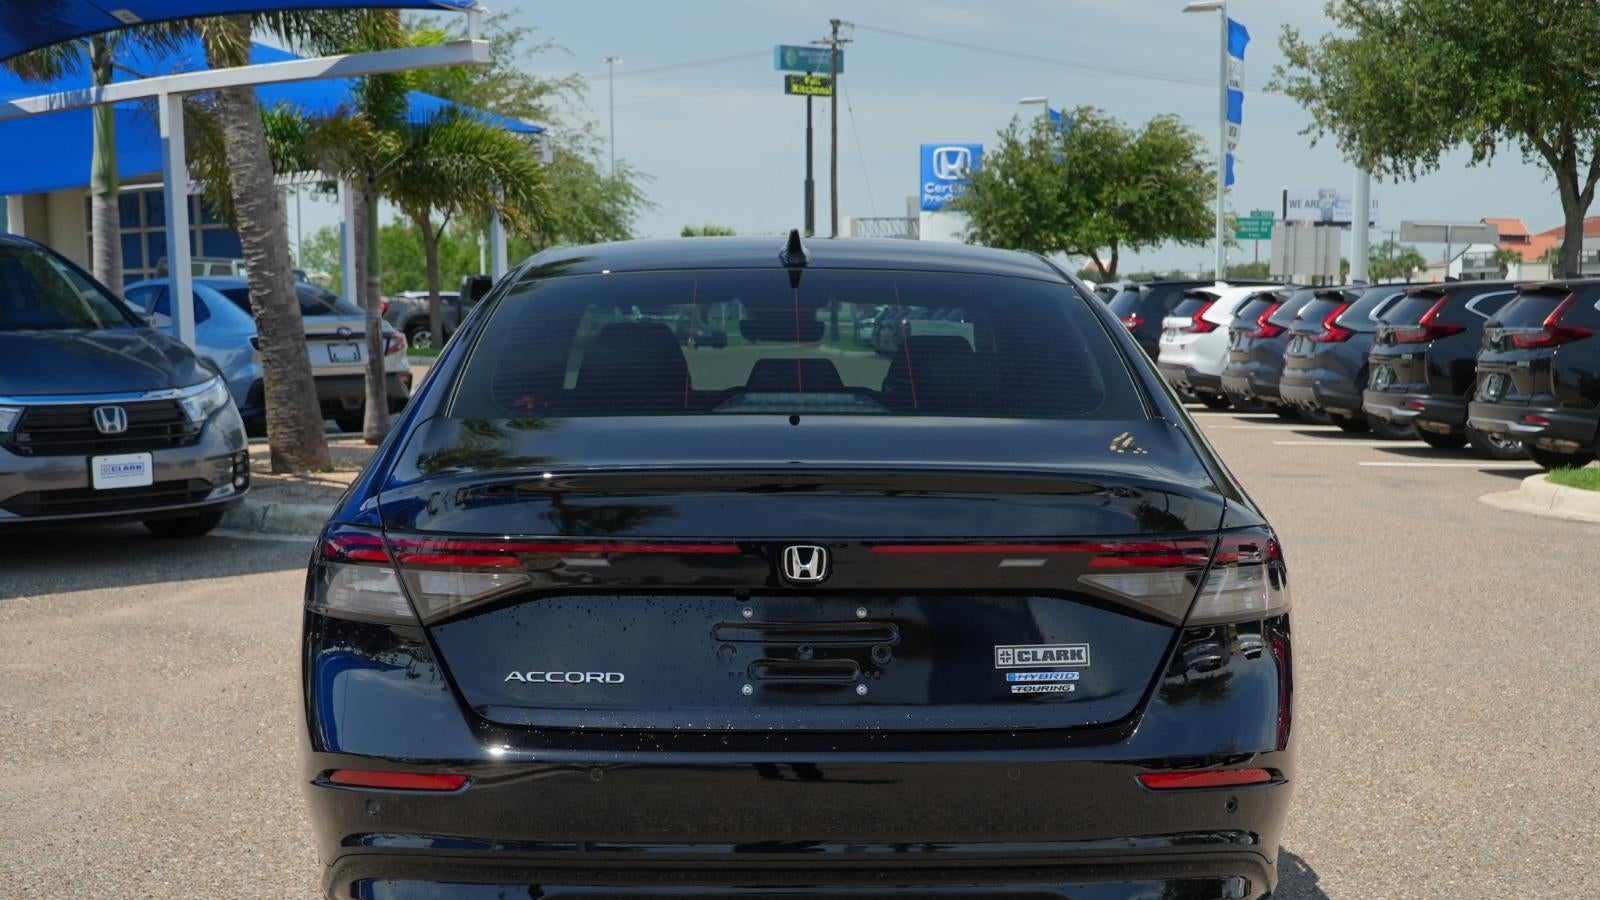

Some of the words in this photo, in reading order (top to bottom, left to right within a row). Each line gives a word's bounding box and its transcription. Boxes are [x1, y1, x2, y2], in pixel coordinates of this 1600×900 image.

[1289, 199, 1302, 209] WE
[1016, 648, 1084, 663] CLARK
[503, 670, 625, 684] ACCORD
[1017, 672, 1075, 681] HYBRID
[1014, 684, 1072, 692] TOURING
